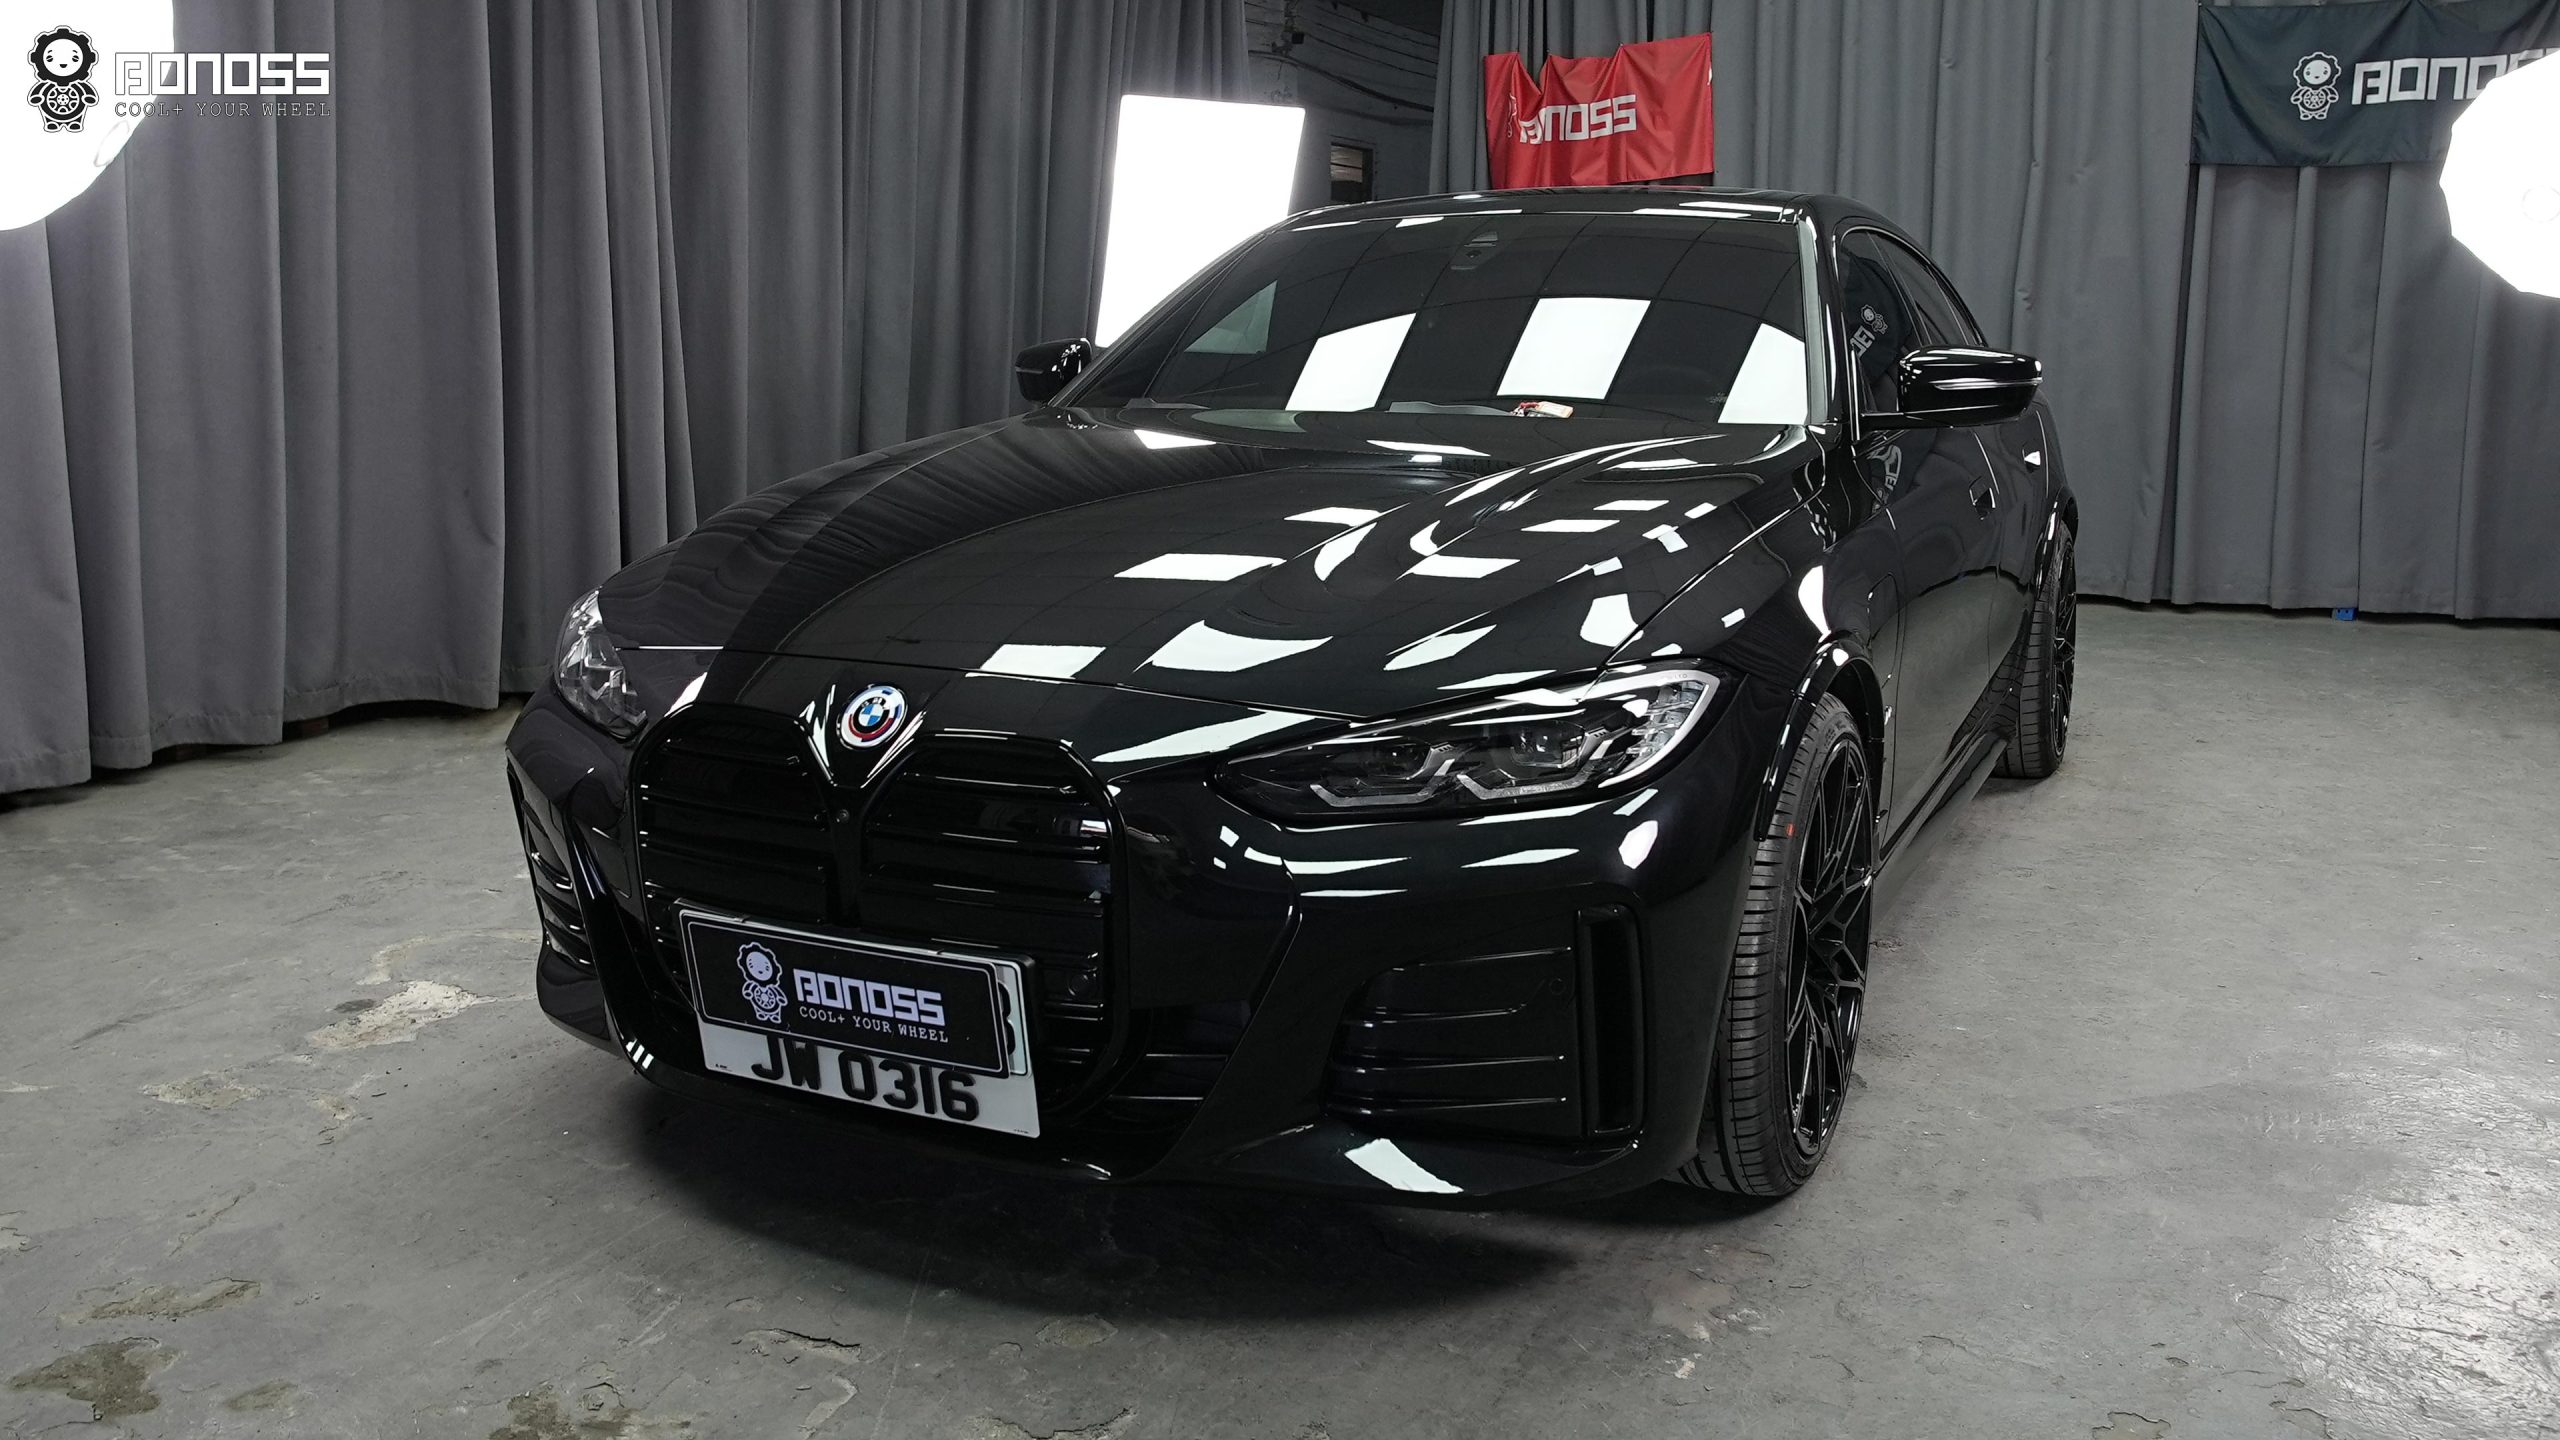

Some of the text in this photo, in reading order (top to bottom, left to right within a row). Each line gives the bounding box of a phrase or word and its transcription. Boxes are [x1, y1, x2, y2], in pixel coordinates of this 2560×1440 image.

[2351, 48, 2560, 105] BONO
[792, 968, 946, 1027] BONOSS
[799, 1006, 949, 1044] COOL+ YOUR WHEEL
[751, 1034, 980, 1122] JW 0316
